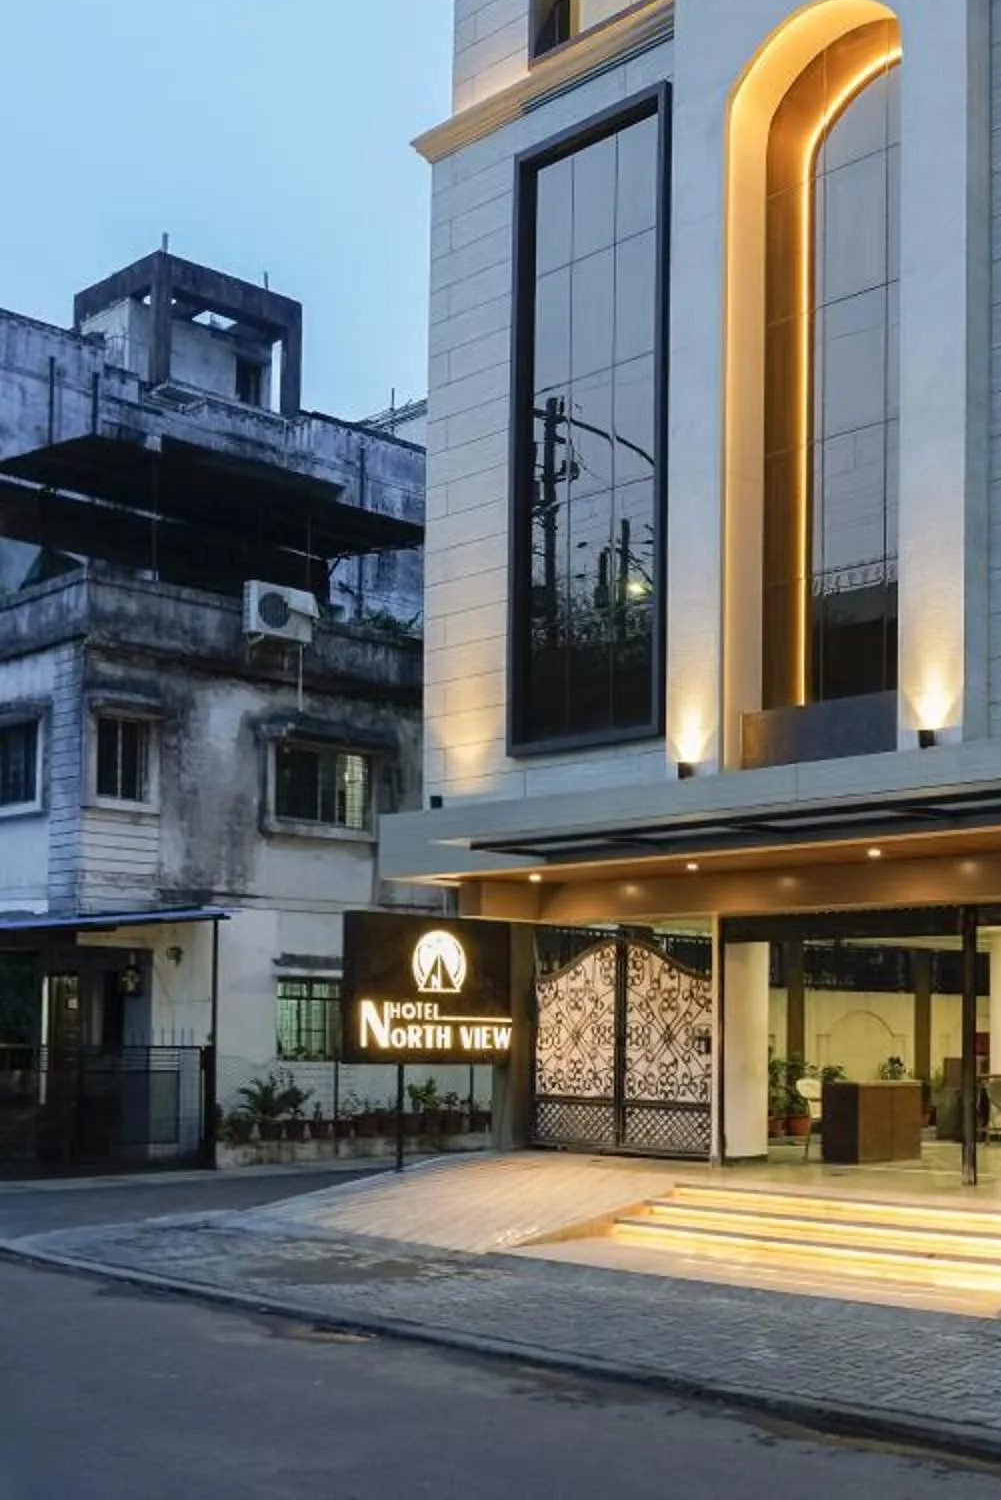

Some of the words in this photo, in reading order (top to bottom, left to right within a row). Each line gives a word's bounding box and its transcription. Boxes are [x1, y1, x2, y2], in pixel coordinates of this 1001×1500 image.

[360, 1000, 452, 1049] NORTH
[460, 1026, 512, 1049] VIEW
[389, 1002, 440, 1020] HOTEL
